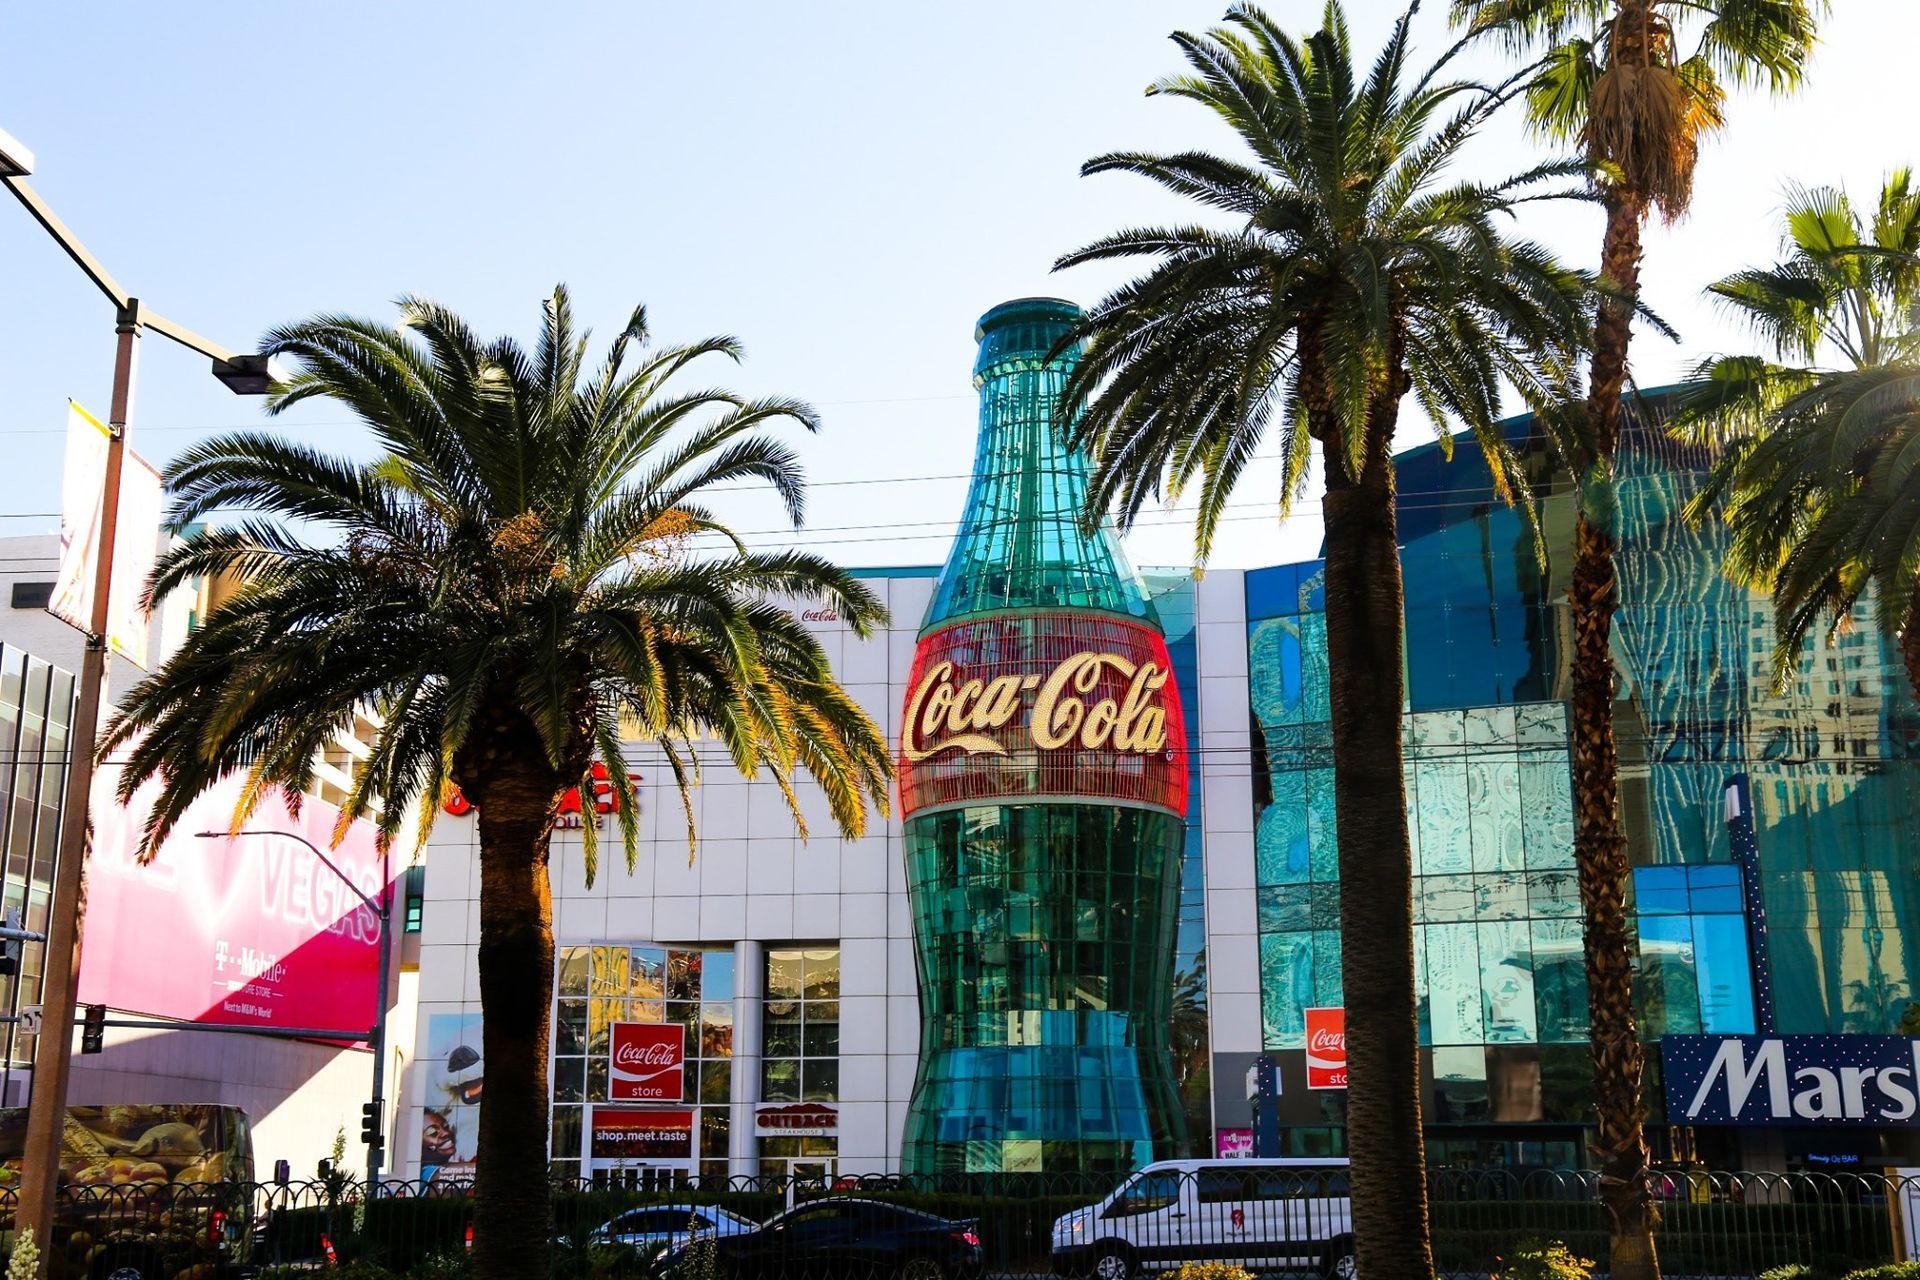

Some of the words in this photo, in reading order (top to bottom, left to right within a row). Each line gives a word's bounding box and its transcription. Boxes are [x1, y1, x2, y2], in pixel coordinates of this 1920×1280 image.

[802, 609, 837, 622] Coca-Cola
[902, 650, 1169, 762] Coca-Cola
[259, 835, 382, 945] VEGAS
[616, 1042, 678, 1065] Coca-Cola
[632, 1086, 663, 1097] store
[757, 1114, 837, 1129] OUTBACK
